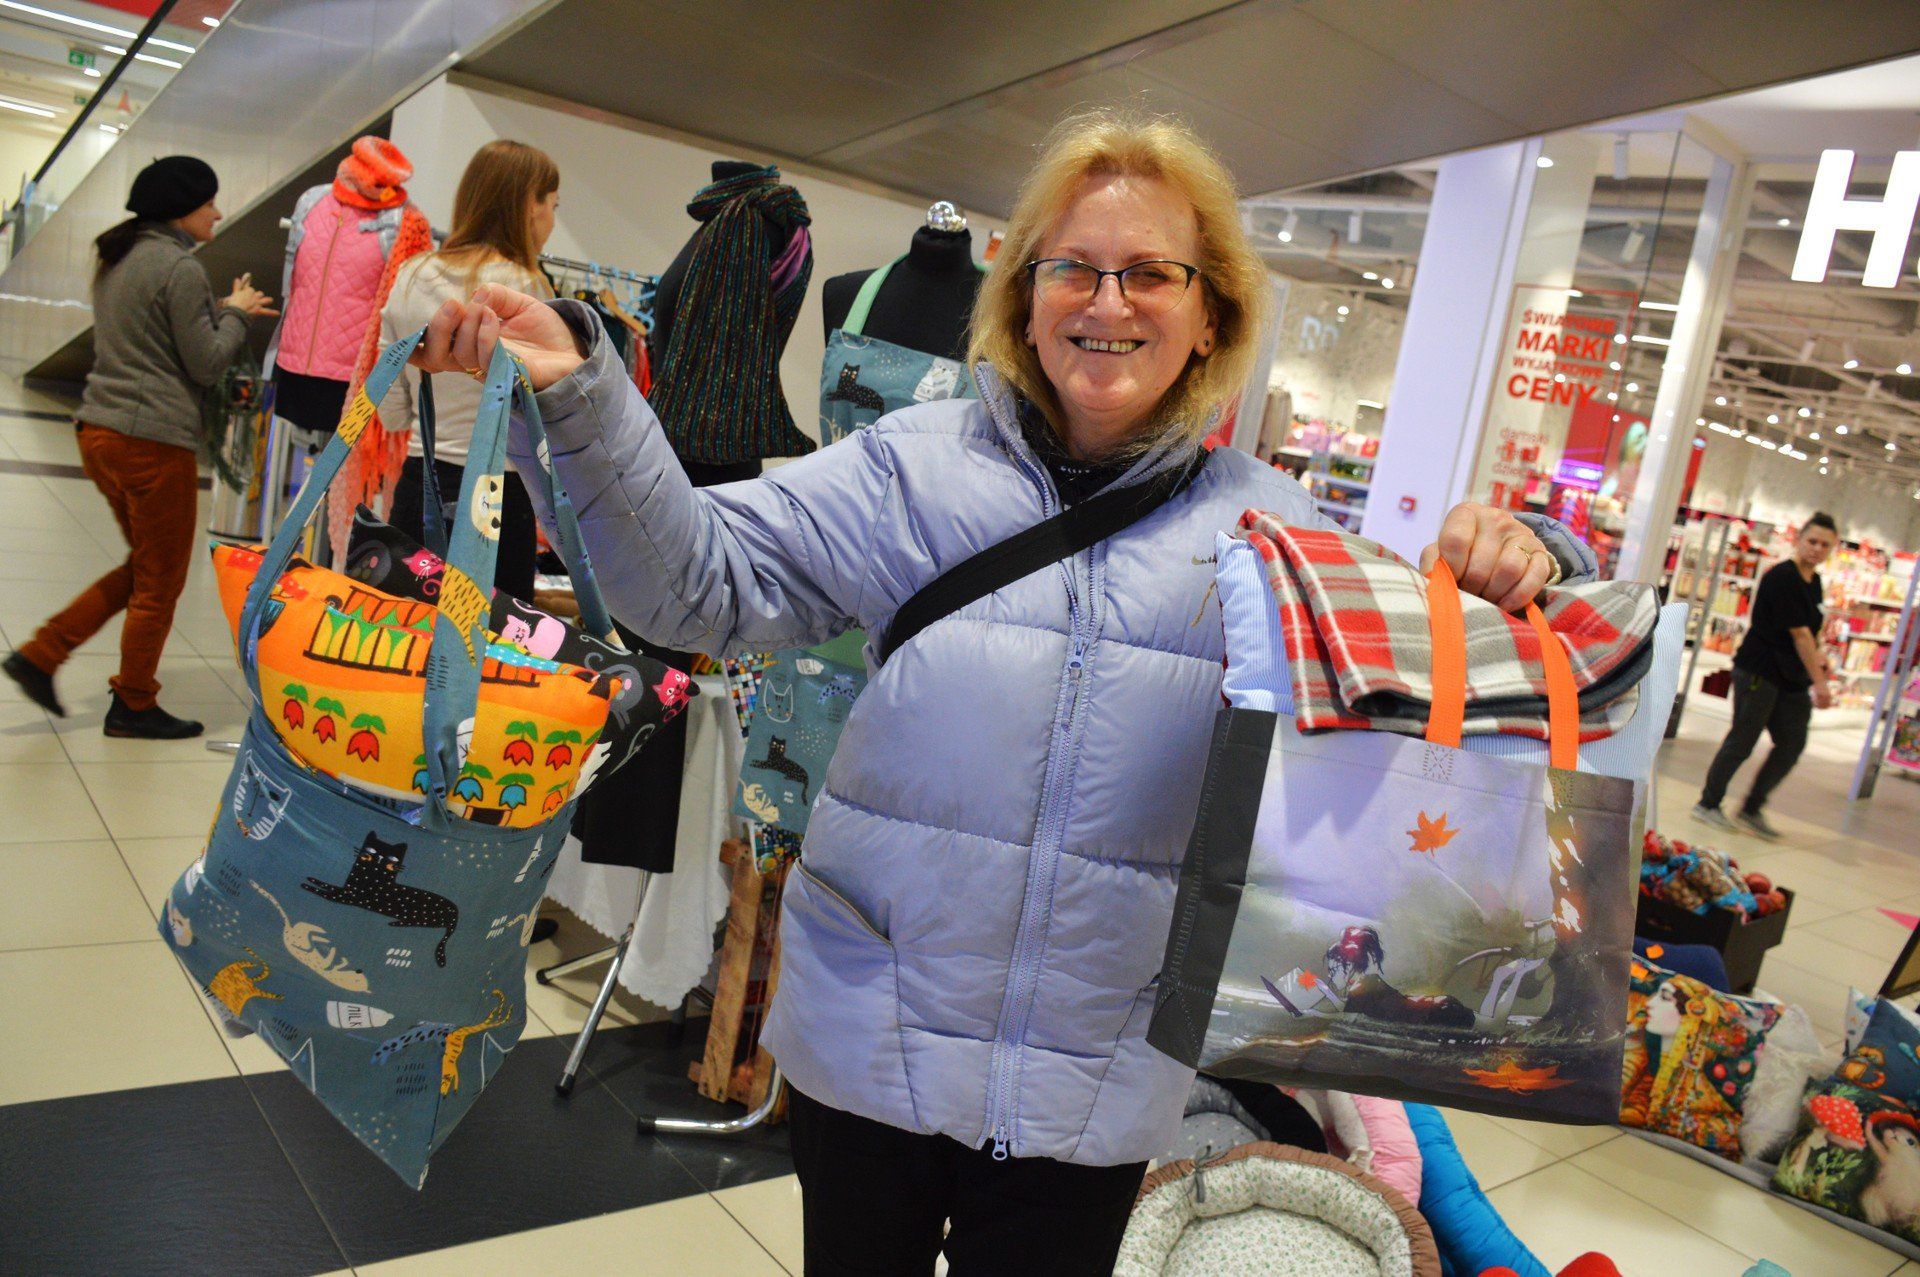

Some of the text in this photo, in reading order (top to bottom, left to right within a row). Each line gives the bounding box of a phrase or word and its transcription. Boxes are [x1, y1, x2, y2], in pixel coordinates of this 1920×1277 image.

[1791, 149, 1920, 289] H
[1517, 330, 1611, 363] MARKI
[1507, 374, 1600, 410] CENY
[347, 1005, 362, 1027] MILK
